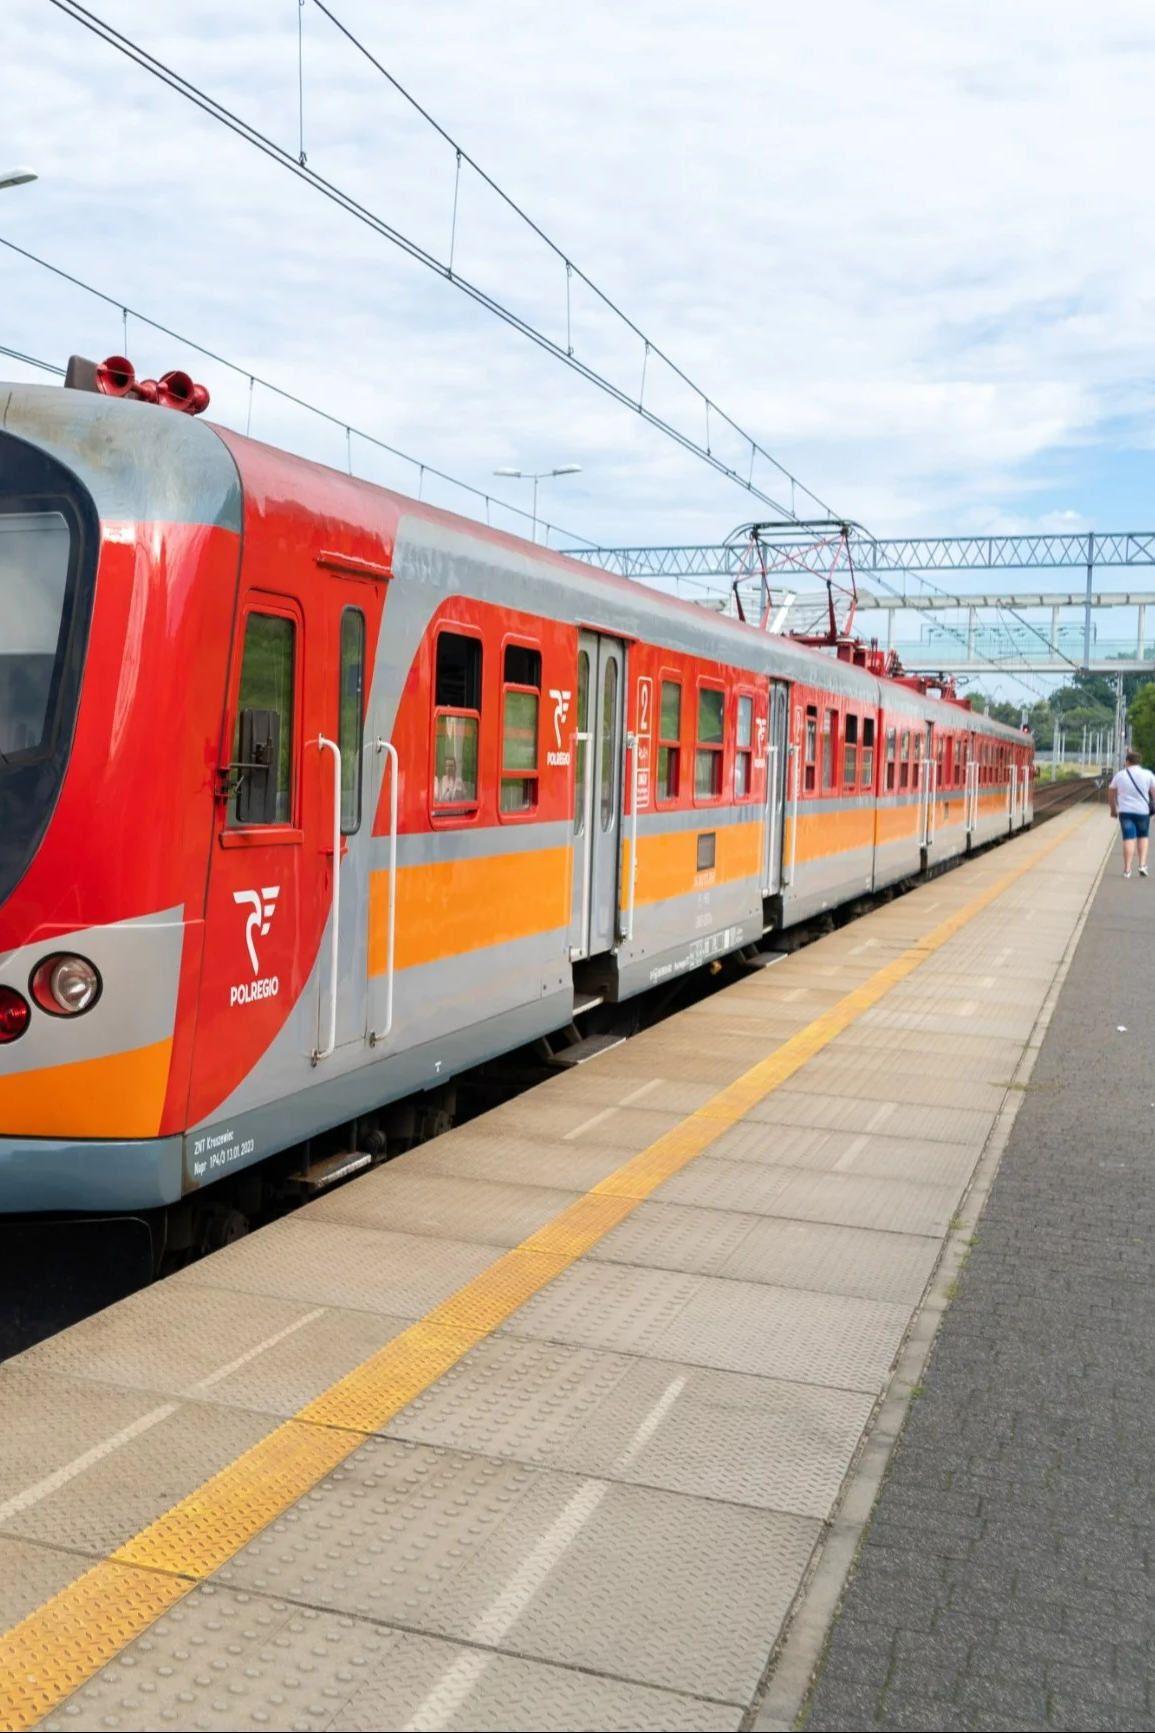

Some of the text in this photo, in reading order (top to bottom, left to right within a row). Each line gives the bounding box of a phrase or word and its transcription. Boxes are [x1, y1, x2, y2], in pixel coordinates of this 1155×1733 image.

[641, 683, 649, 730] 2
[230, 976, 279, 1007] POLREGIO
[194, 1139, 206, 1156] ZNT
